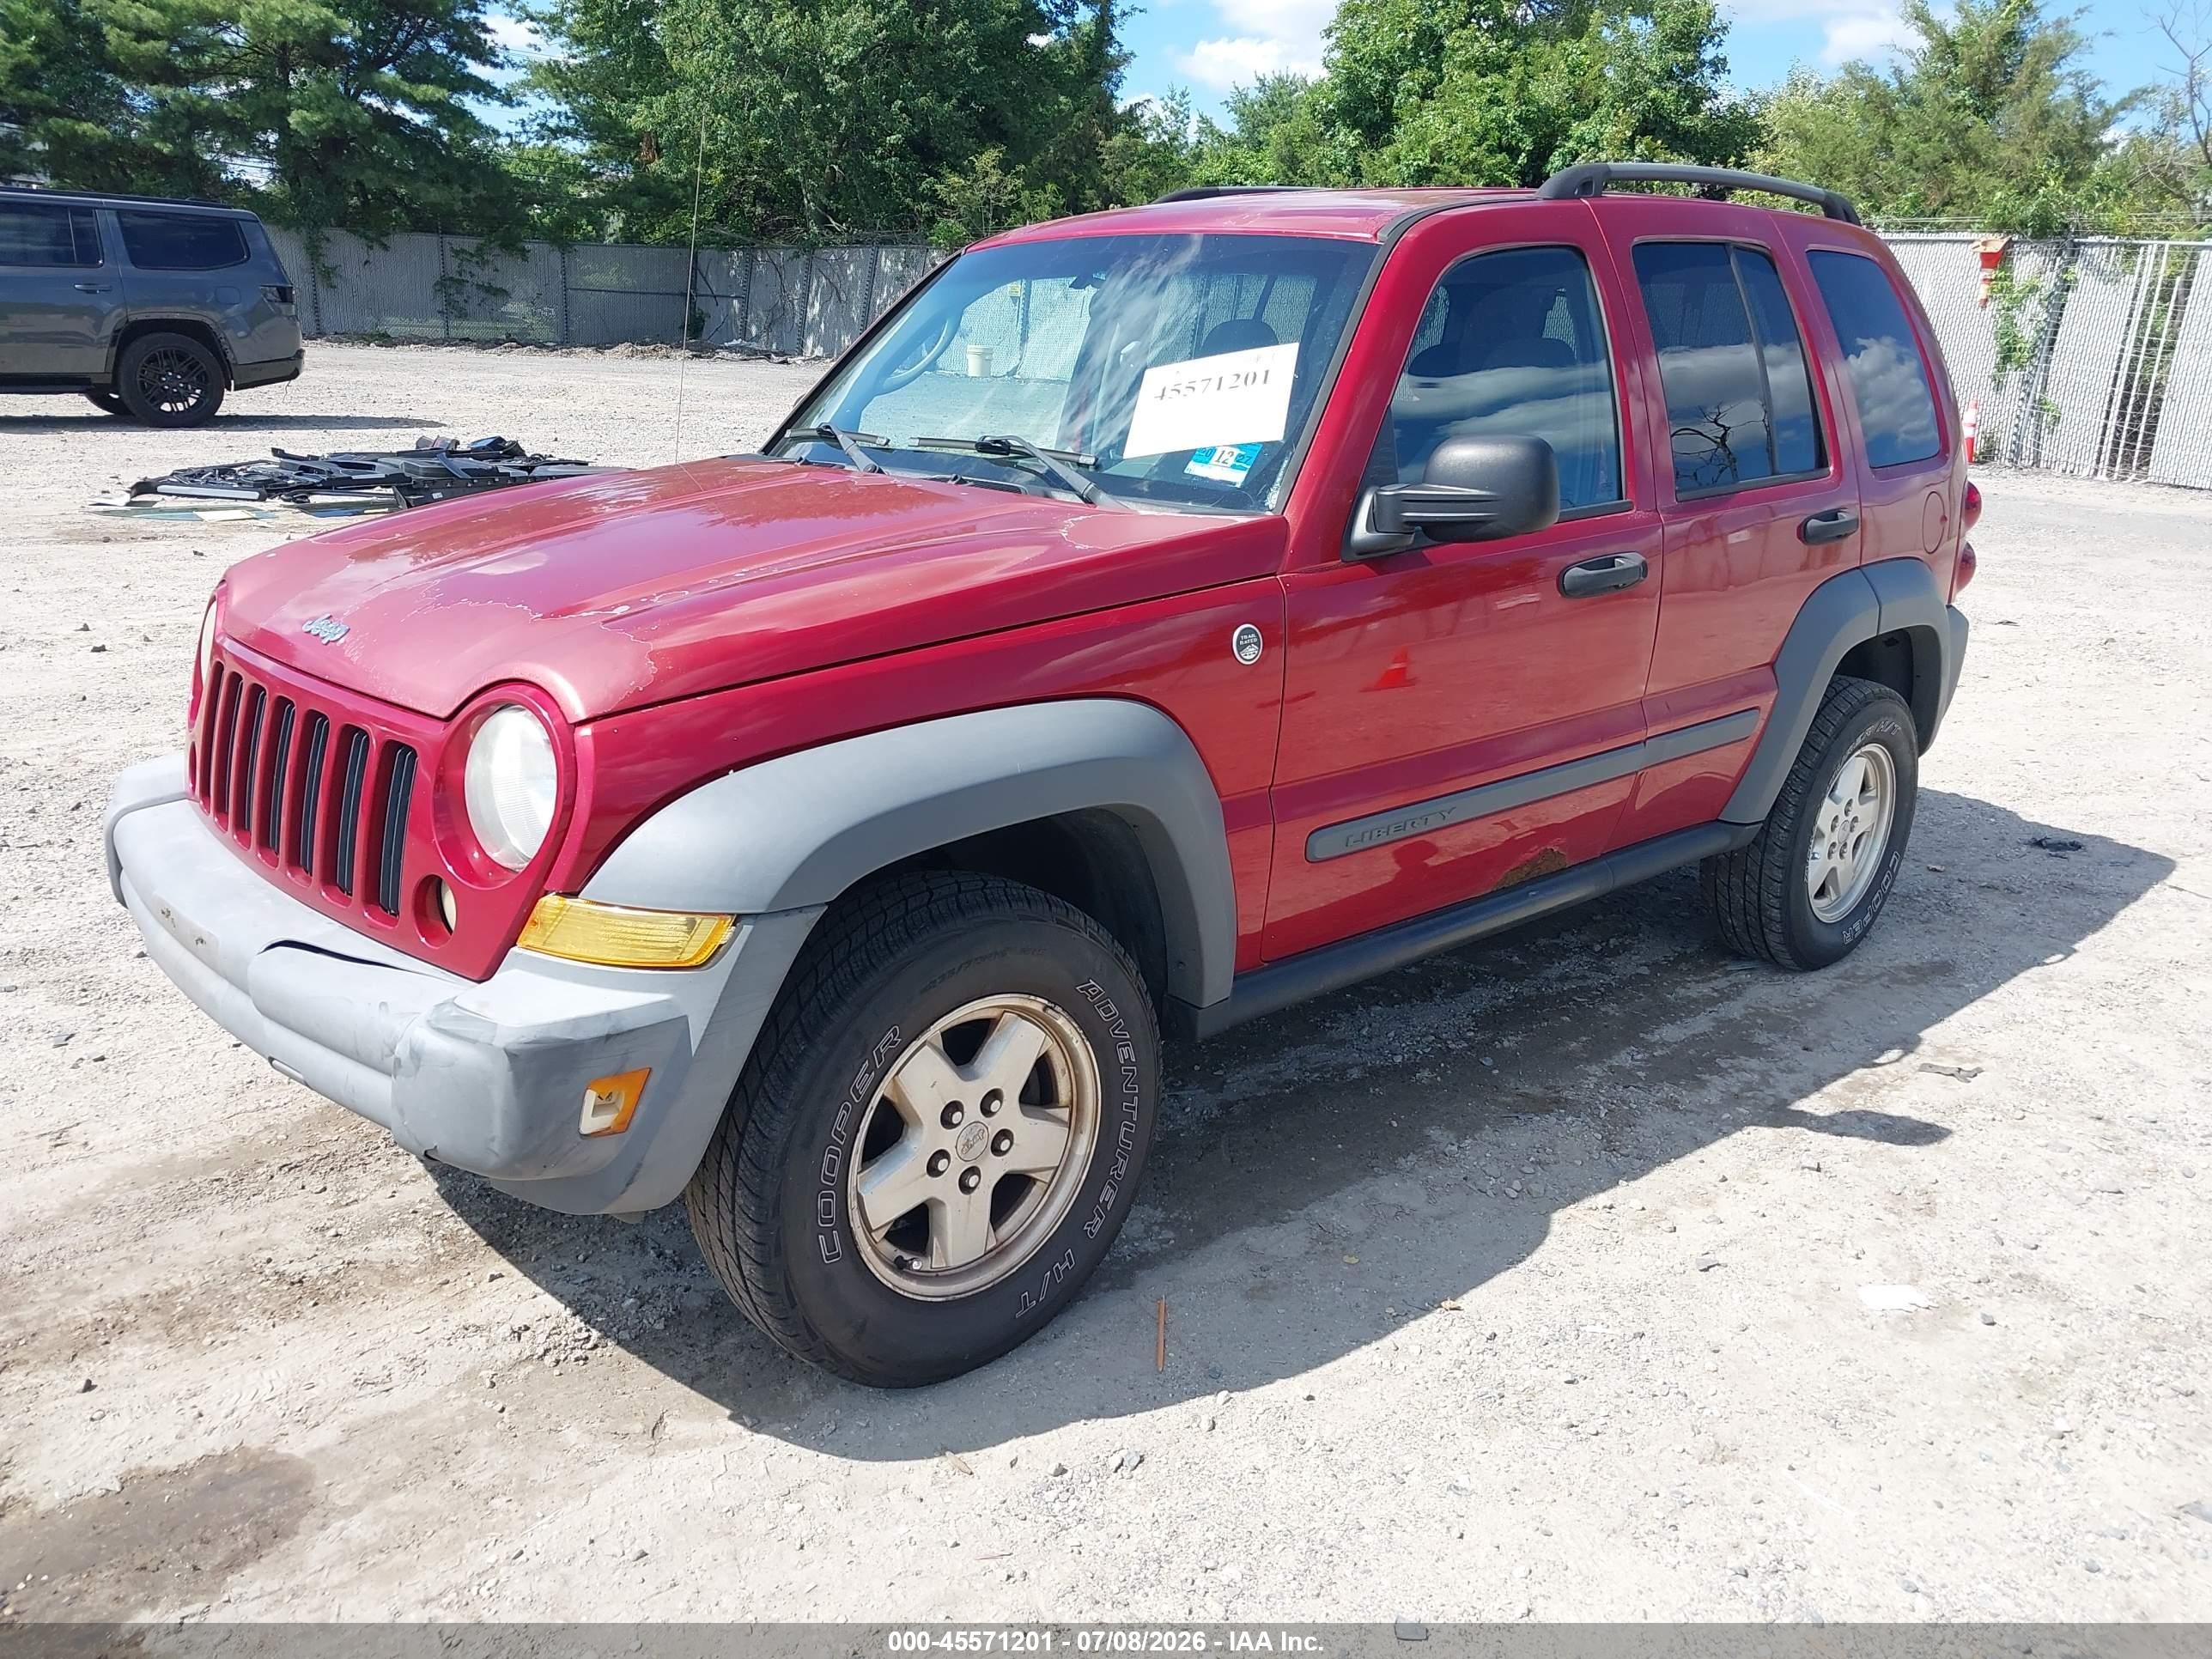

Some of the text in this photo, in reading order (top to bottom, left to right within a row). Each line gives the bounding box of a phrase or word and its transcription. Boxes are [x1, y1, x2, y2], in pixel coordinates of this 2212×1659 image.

[1154, 368, 1270, 400] 45571201
[1214, 450, 1235, 465] 12
[302, 614, 350, 646] Jeep
[1345, 806, 1457, 848] LIBERTY
[1842, 850, 1900, 945] COOPER
[817, 1024, 902, 1265] COOPER
[1015, 978, 1139, 1320] ADVENTURER H/T
